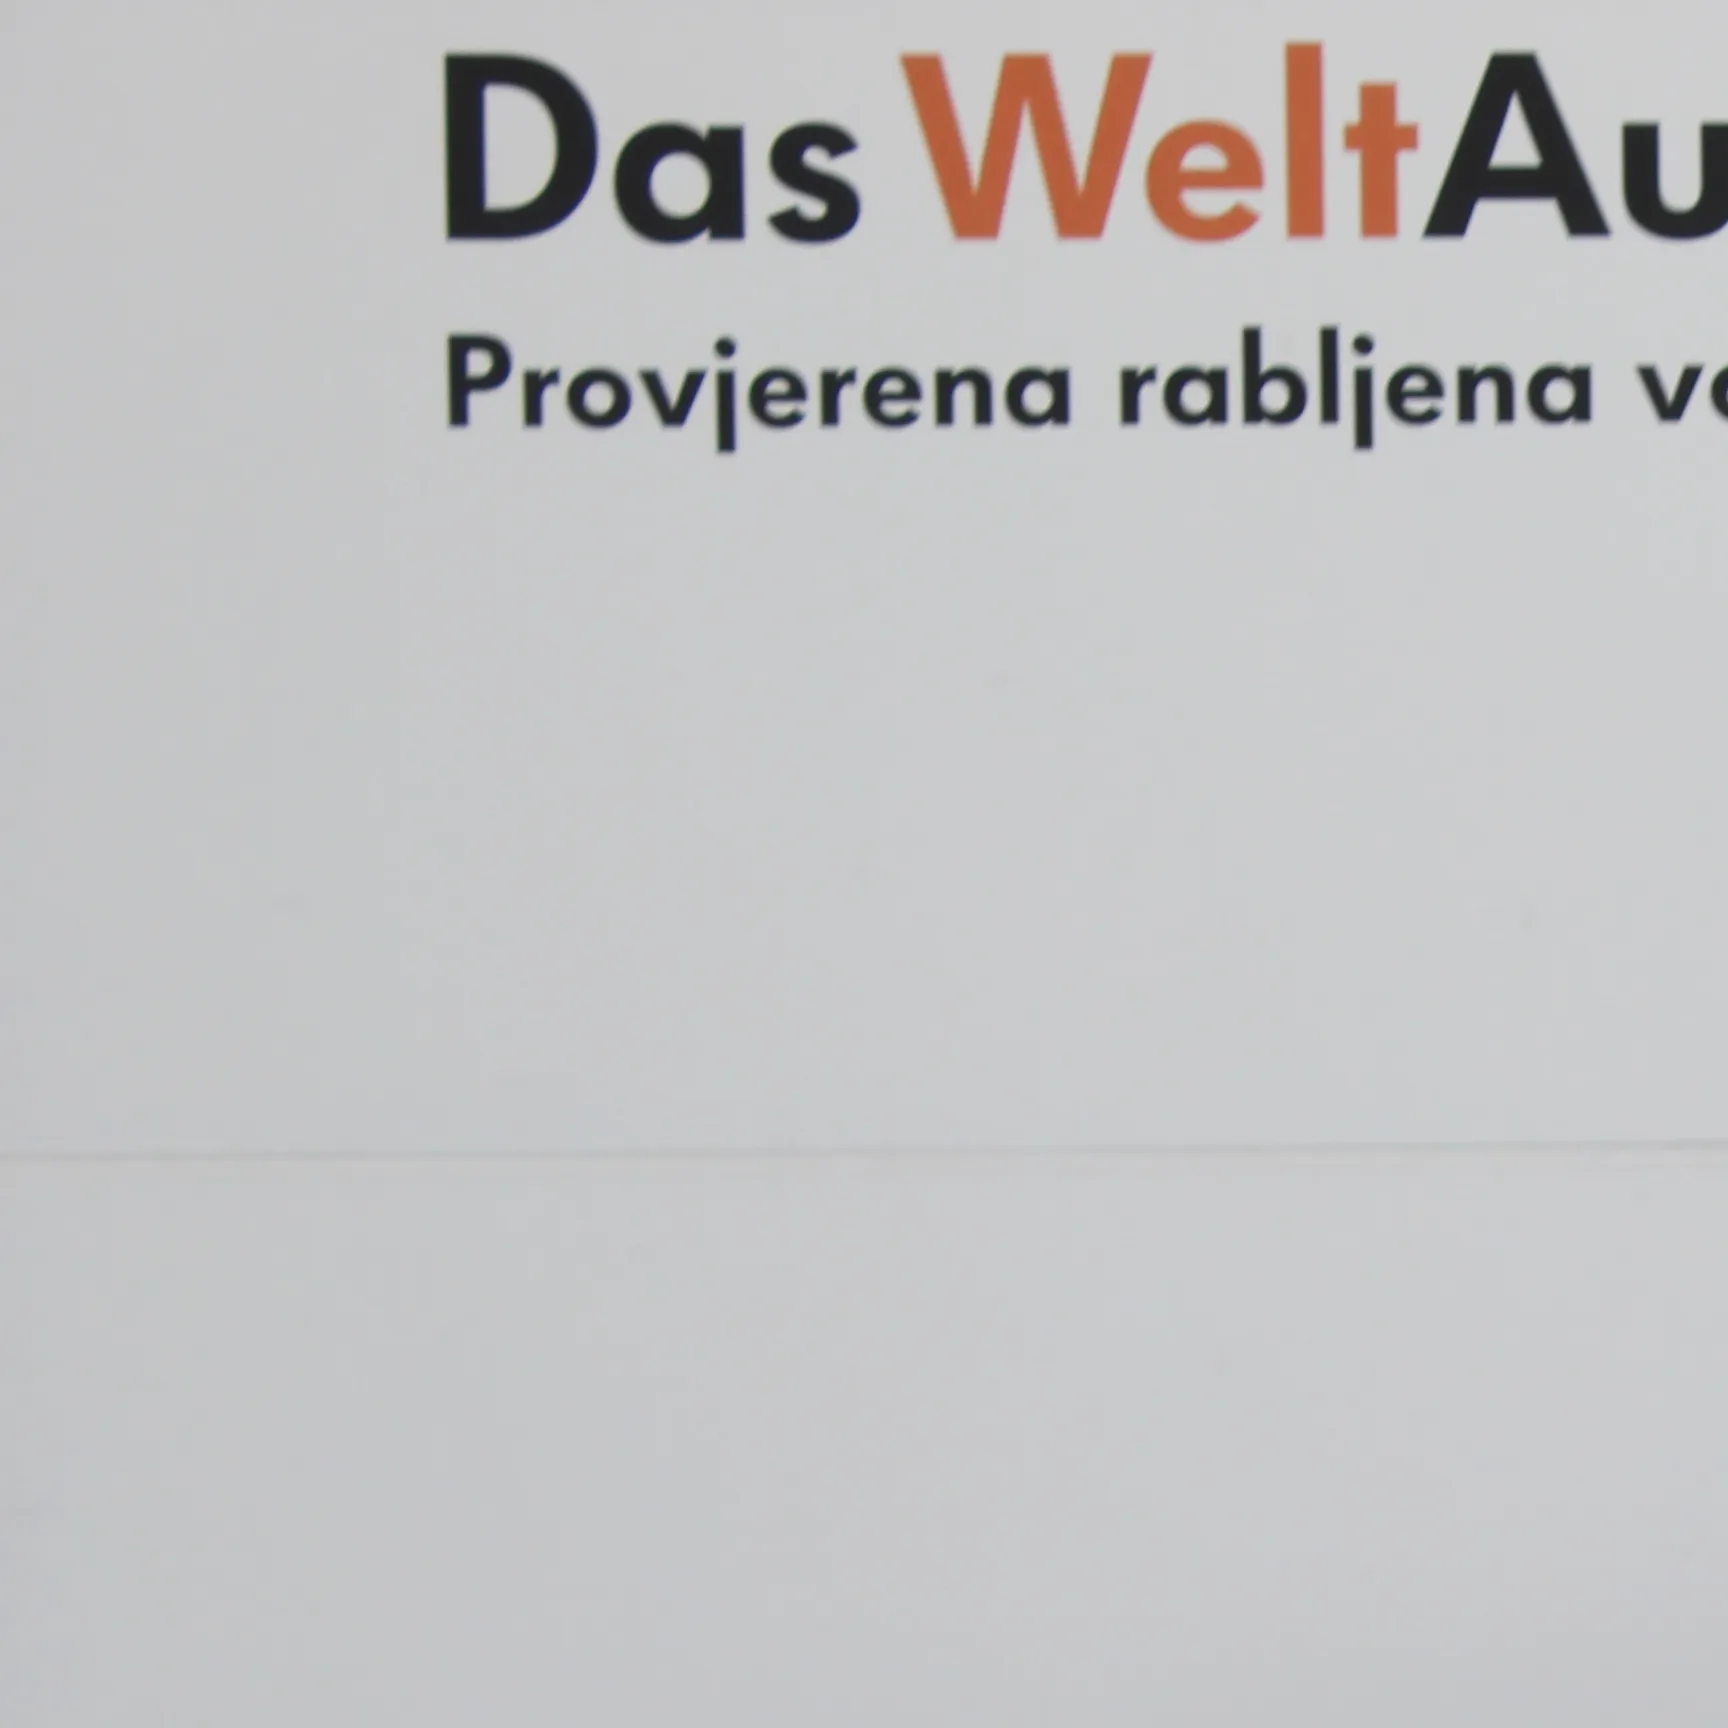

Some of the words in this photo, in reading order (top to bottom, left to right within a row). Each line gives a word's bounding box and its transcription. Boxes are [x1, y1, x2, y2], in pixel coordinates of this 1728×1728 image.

[443, 52, 862, 245] Das
[446, 333, 1072, 454] Provjerena
[1119, 325, 1593, 451] rabljena
